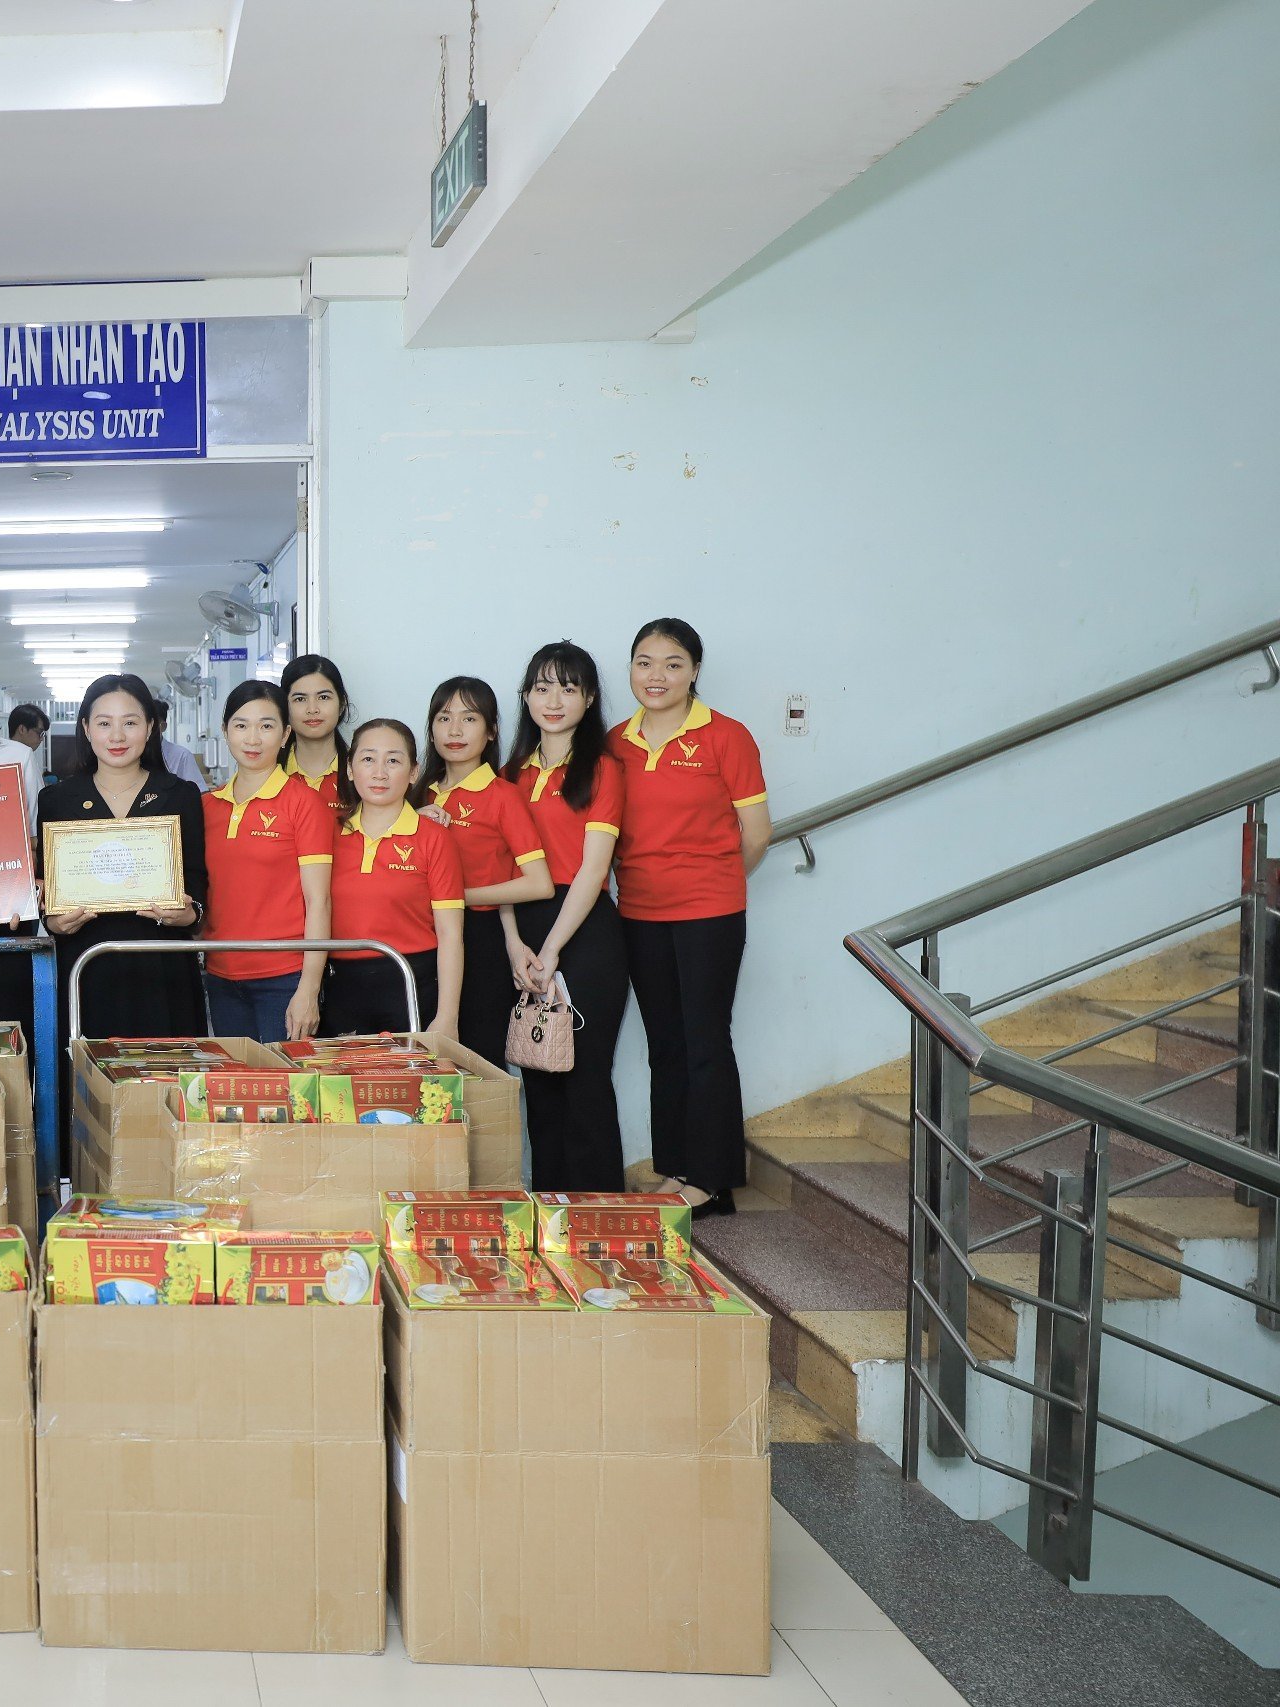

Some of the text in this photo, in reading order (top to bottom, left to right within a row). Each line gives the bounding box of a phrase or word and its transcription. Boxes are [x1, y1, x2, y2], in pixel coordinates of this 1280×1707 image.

[435, 124, 469, 227] EXIT
[131, 322, 185, 397] TẠO
[102, 408, 165, 439] UNIT
[670, 759, 703, 768] HVNEST
